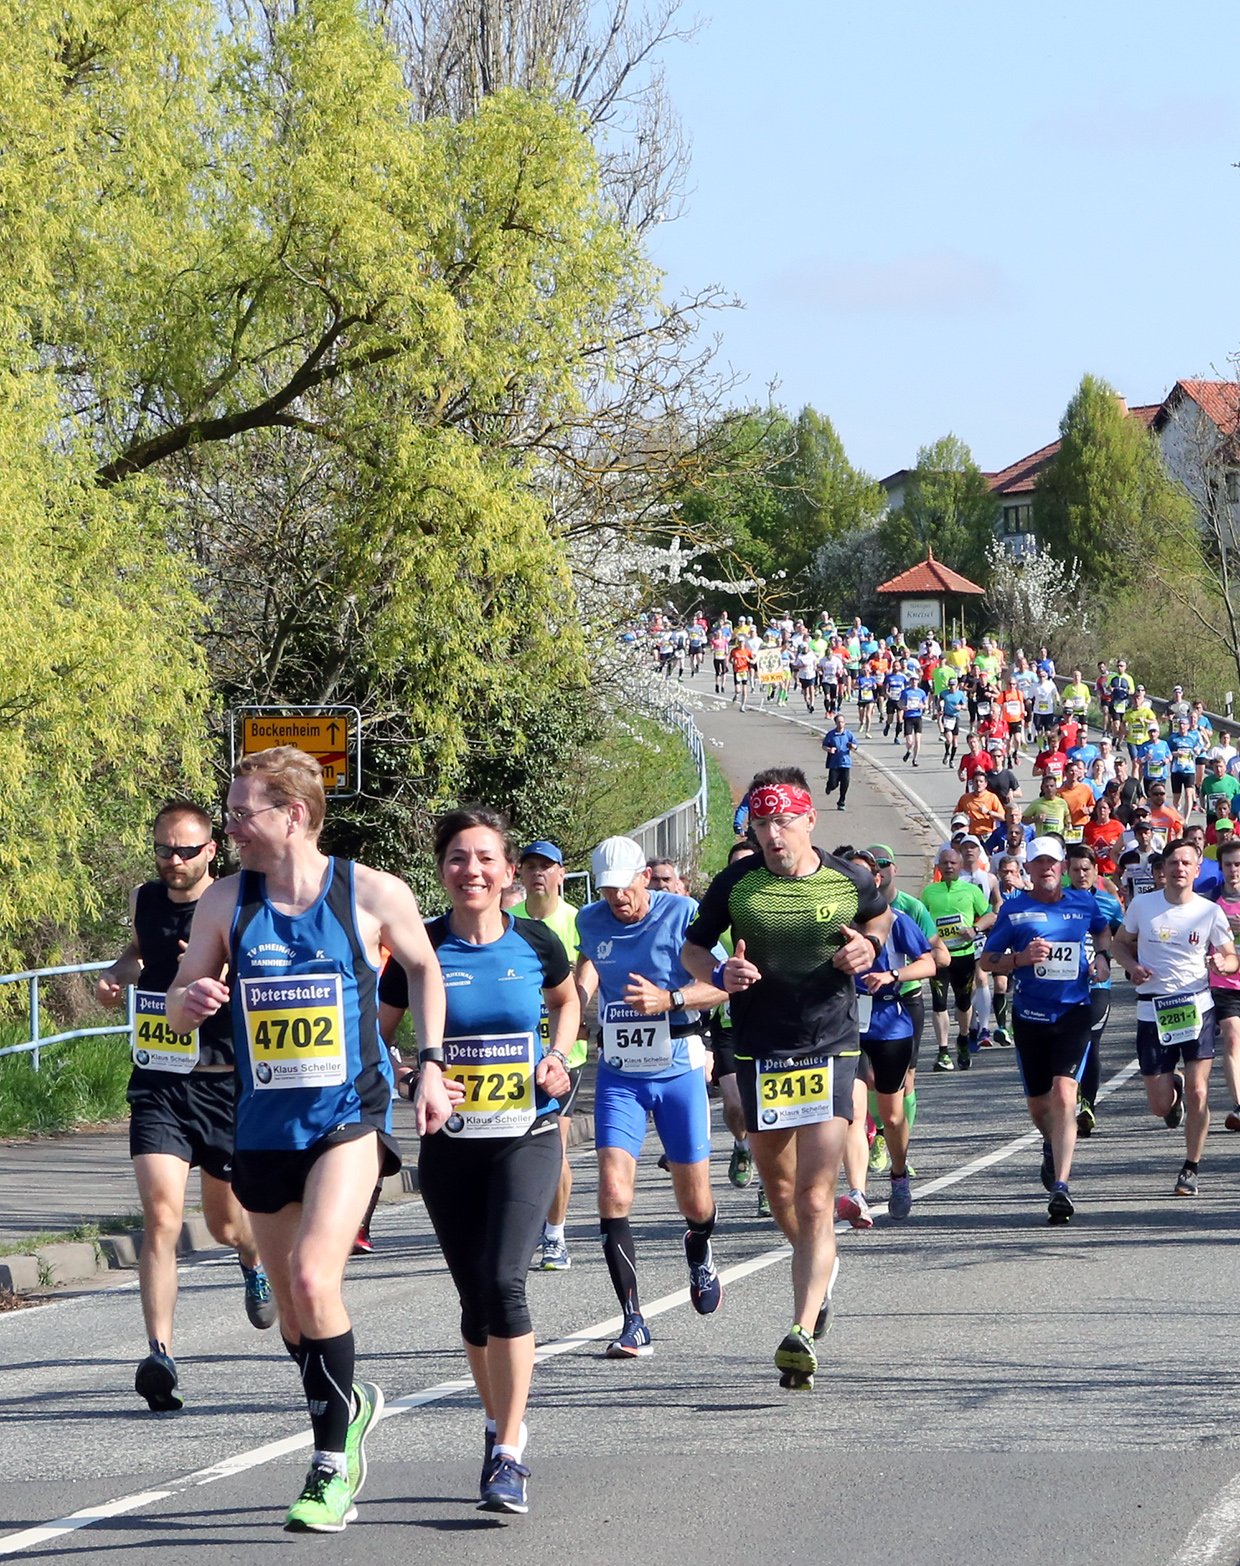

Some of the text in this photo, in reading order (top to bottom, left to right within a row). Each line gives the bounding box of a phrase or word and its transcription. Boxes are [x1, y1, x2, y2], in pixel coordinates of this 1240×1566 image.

[251, 723, 320, 737] Bockenheim
[246, 943, 297, 958] TV RHEINAU
[250, 986, 331, 1006] Peterstaler
[140, 997, 166, 1010] Peter
[610, 1008, 661, 1019] Peters
[255, 1016, 334, 1050] 4702
[616, 1028, 656, 1048] 547
[448, 1043, 524, 1061] Peterstaler
[274, 1063, 341, 1074] Klaus Scheller
[764, 1074, 824, 1100] 3413
[780, 1109, 799, 1117] Klaus
[801, 1105, 829, 1114] Scheller
[466, 1114, 532, 1124] Klaus Scheller
